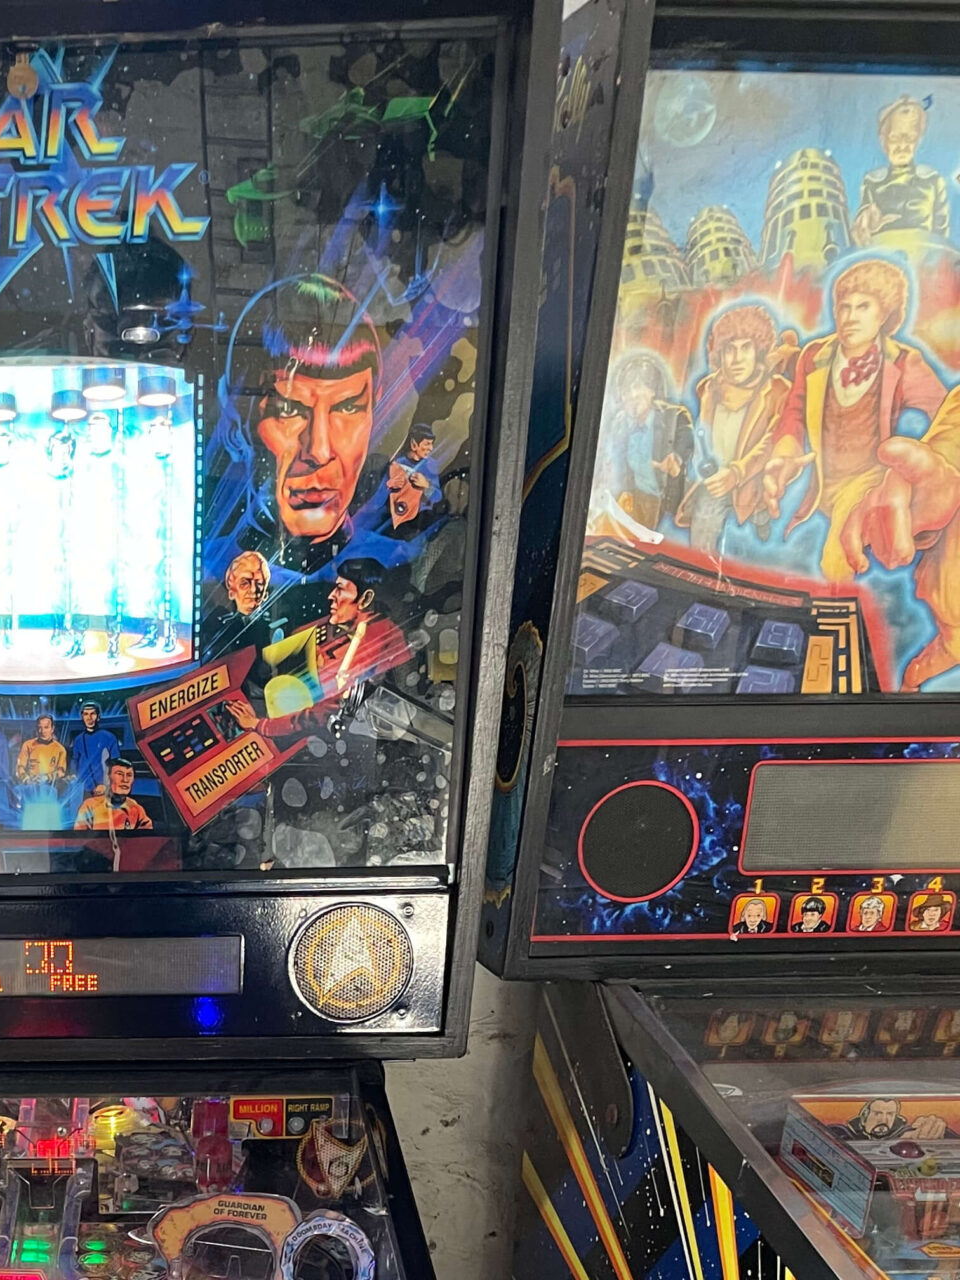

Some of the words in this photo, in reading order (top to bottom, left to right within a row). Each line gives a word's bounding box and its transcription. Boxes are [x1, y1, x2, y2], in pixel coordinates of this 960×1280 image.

[149, 672, 220, 721] ENERGIZE
[185, 740, 265, 804] TRANSPORTER
[753, 878, 764, 894] 1
[812, 878, 826, 893] 2
[872, 877, 885, 893] 3
[928, 876, 943, 893] 4
[50, 974, 98, 992] FREE
[239, 1103, 279, 1114] MILLION
[287, 1103, 308, 1113] RIGHT
[309, 1102, 330, 1113] RAMP
[213, 1208, 228, 1217] OF
[230, 1209, 268, 1221] FOREVER
[217, 1200, 265, 1212] GUARDIAN
[291, 1222, 332, 1242] DOOMSDAY
